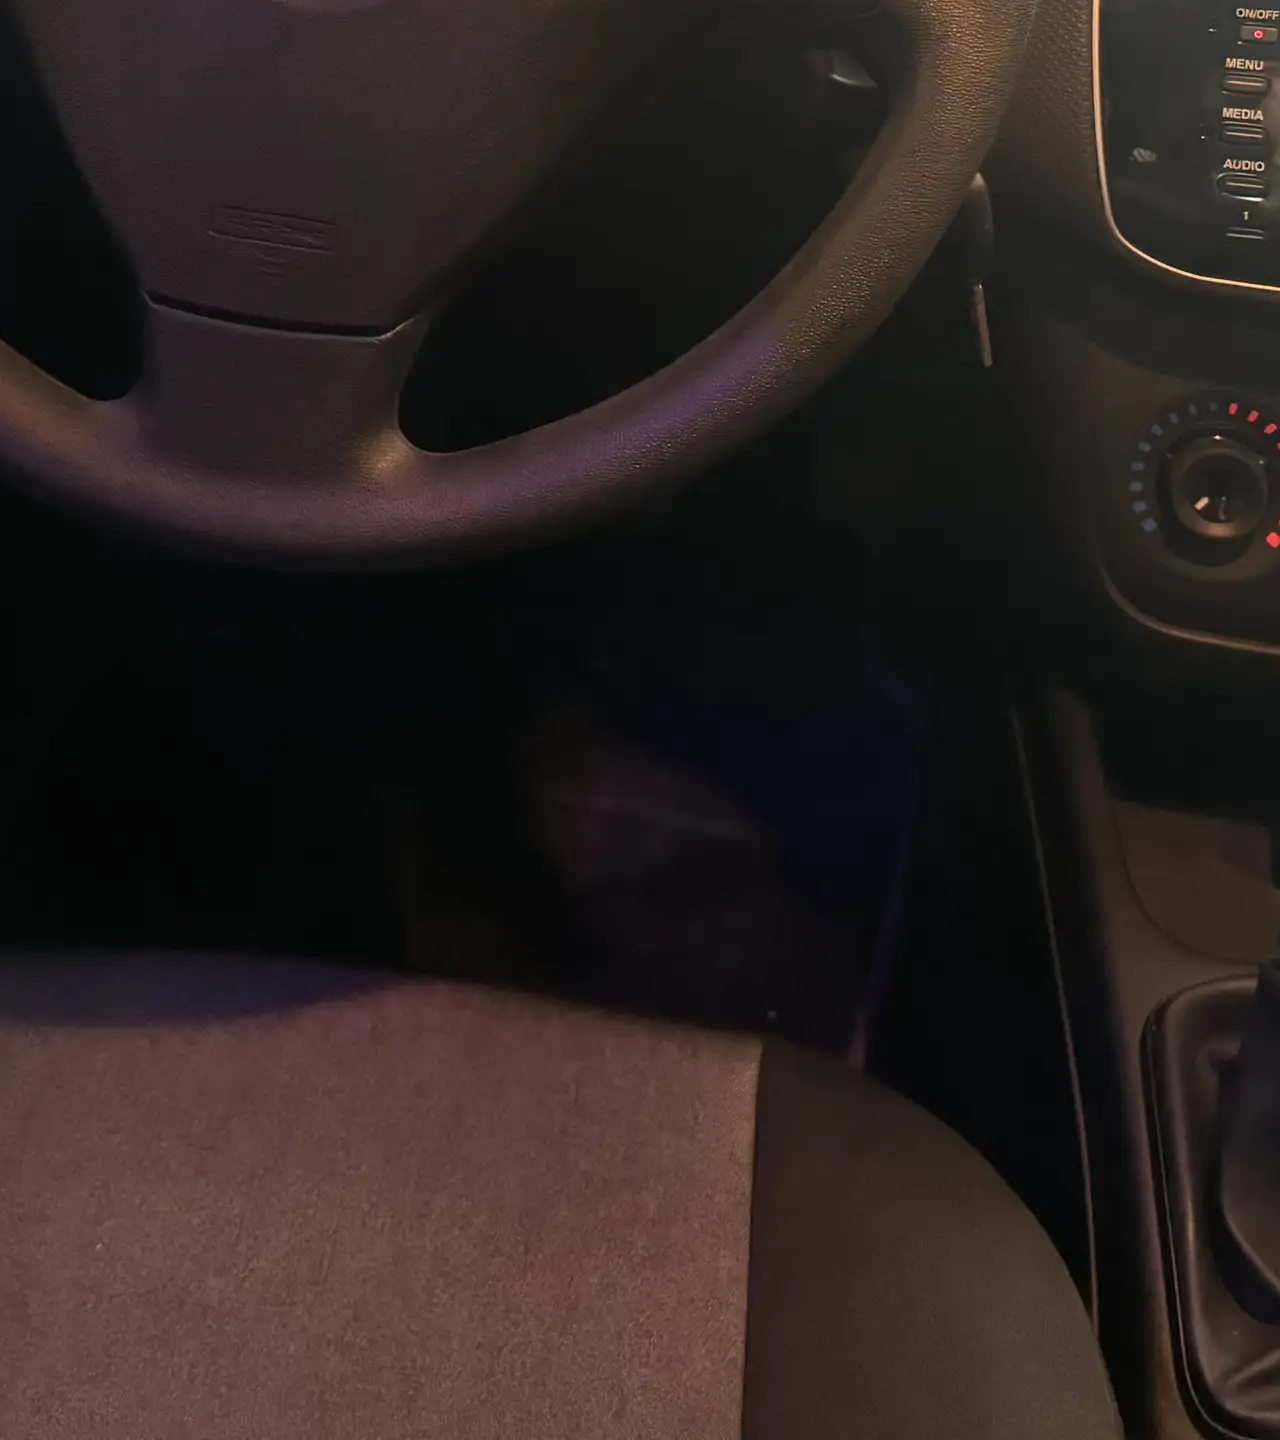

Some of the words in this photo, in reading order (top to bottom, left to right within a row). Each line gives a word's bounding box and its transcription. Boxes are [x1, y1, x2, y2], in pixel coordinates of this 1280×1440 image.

[1235, 7, 1280, 21] ON/OFF
[1225, 57, 1265, 71] MENU
[1222, 107, 1265, 121] MEDIA
[1223, 158, 1265, 172] AUDIO
